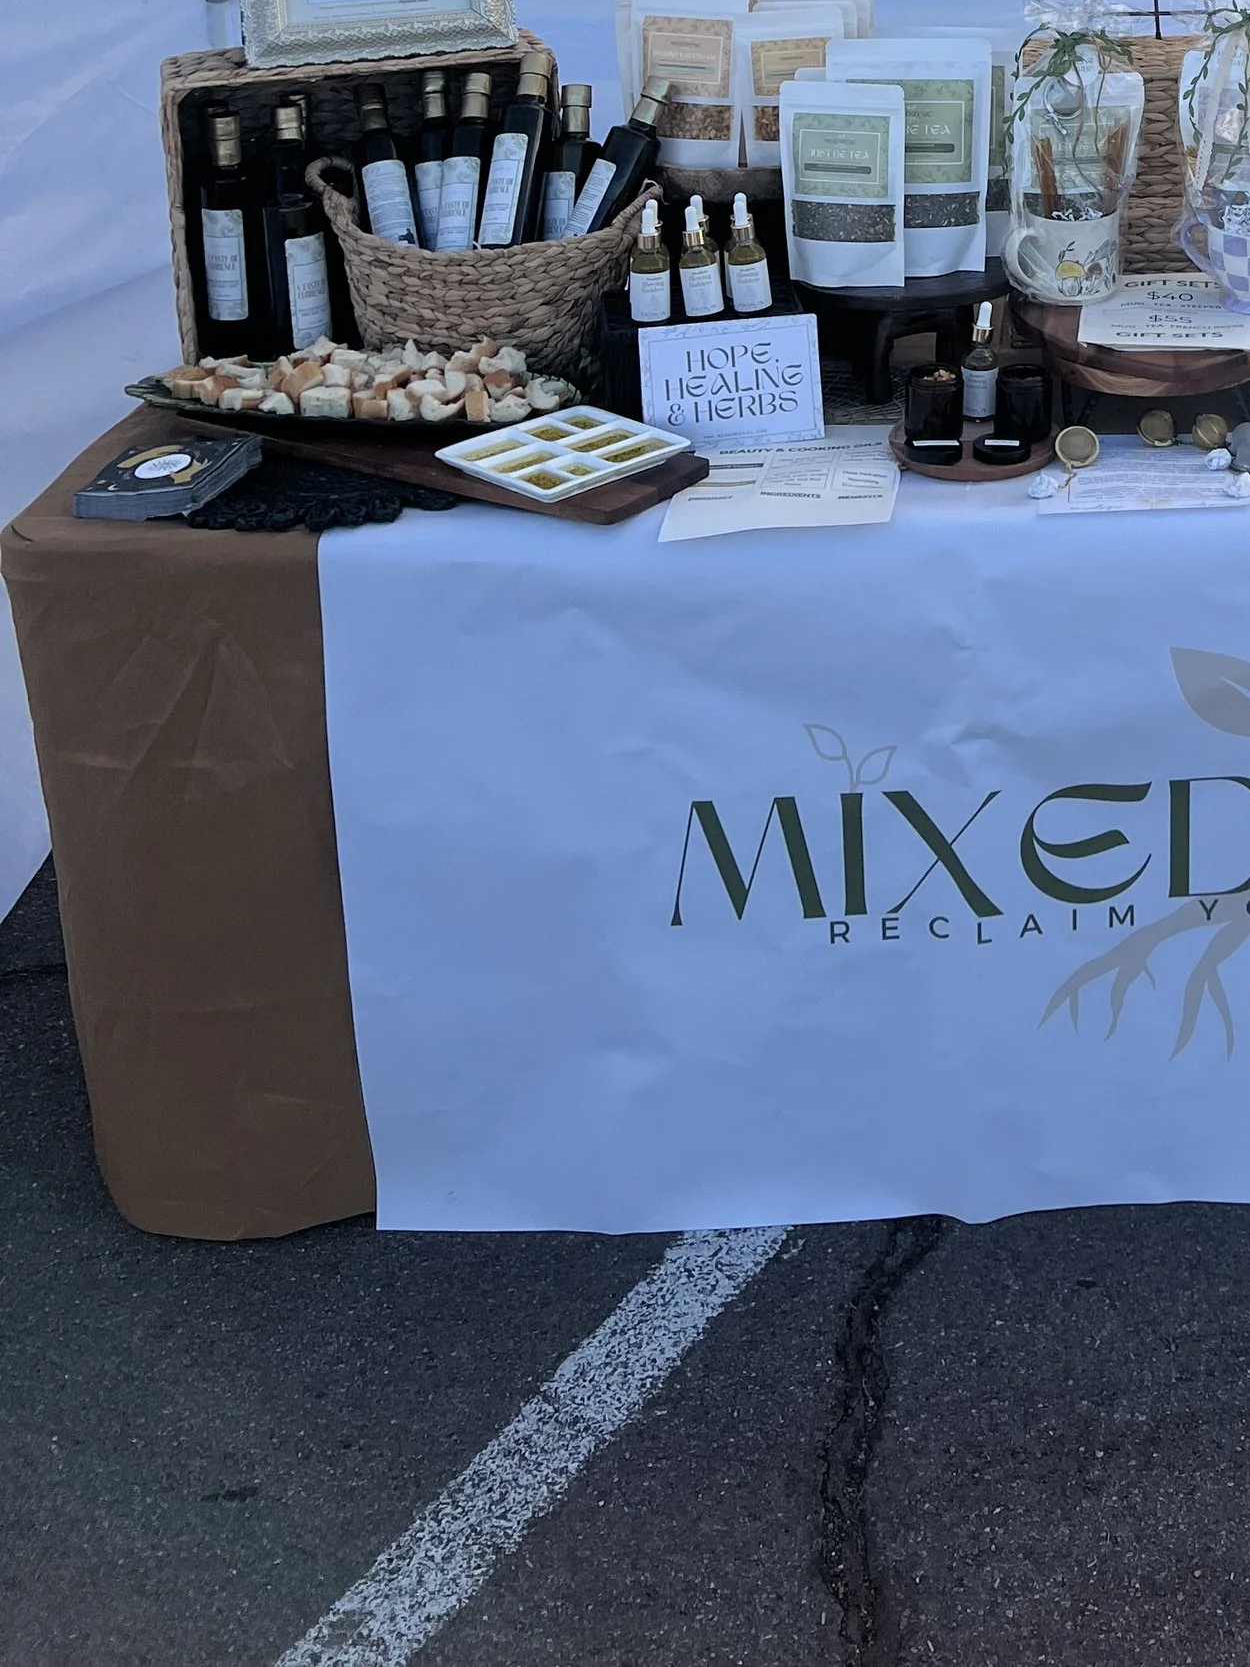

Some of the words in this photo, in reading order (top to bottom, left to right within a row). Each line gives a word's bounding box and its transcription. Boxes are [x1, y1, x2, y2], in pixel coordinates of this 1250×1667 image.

[924, 125, 951, 135] TEA
[1124, 279, 1173, 288] GIFT
[1146, 291, 1194, 302] $40
[1149, 314, 1193, 324] $55
[664, 364, 804, 401] HEALING
[667, 403, 685, 426] &
[694, 390, 799, 423] HERBS
[719, 447, 773, 455] BEAUTY
[789, 444, 851, 453] COOKING
[760, 490, 822, 499] INGREDIENTS
[829, 903, 1136, 945] RECLAIM
